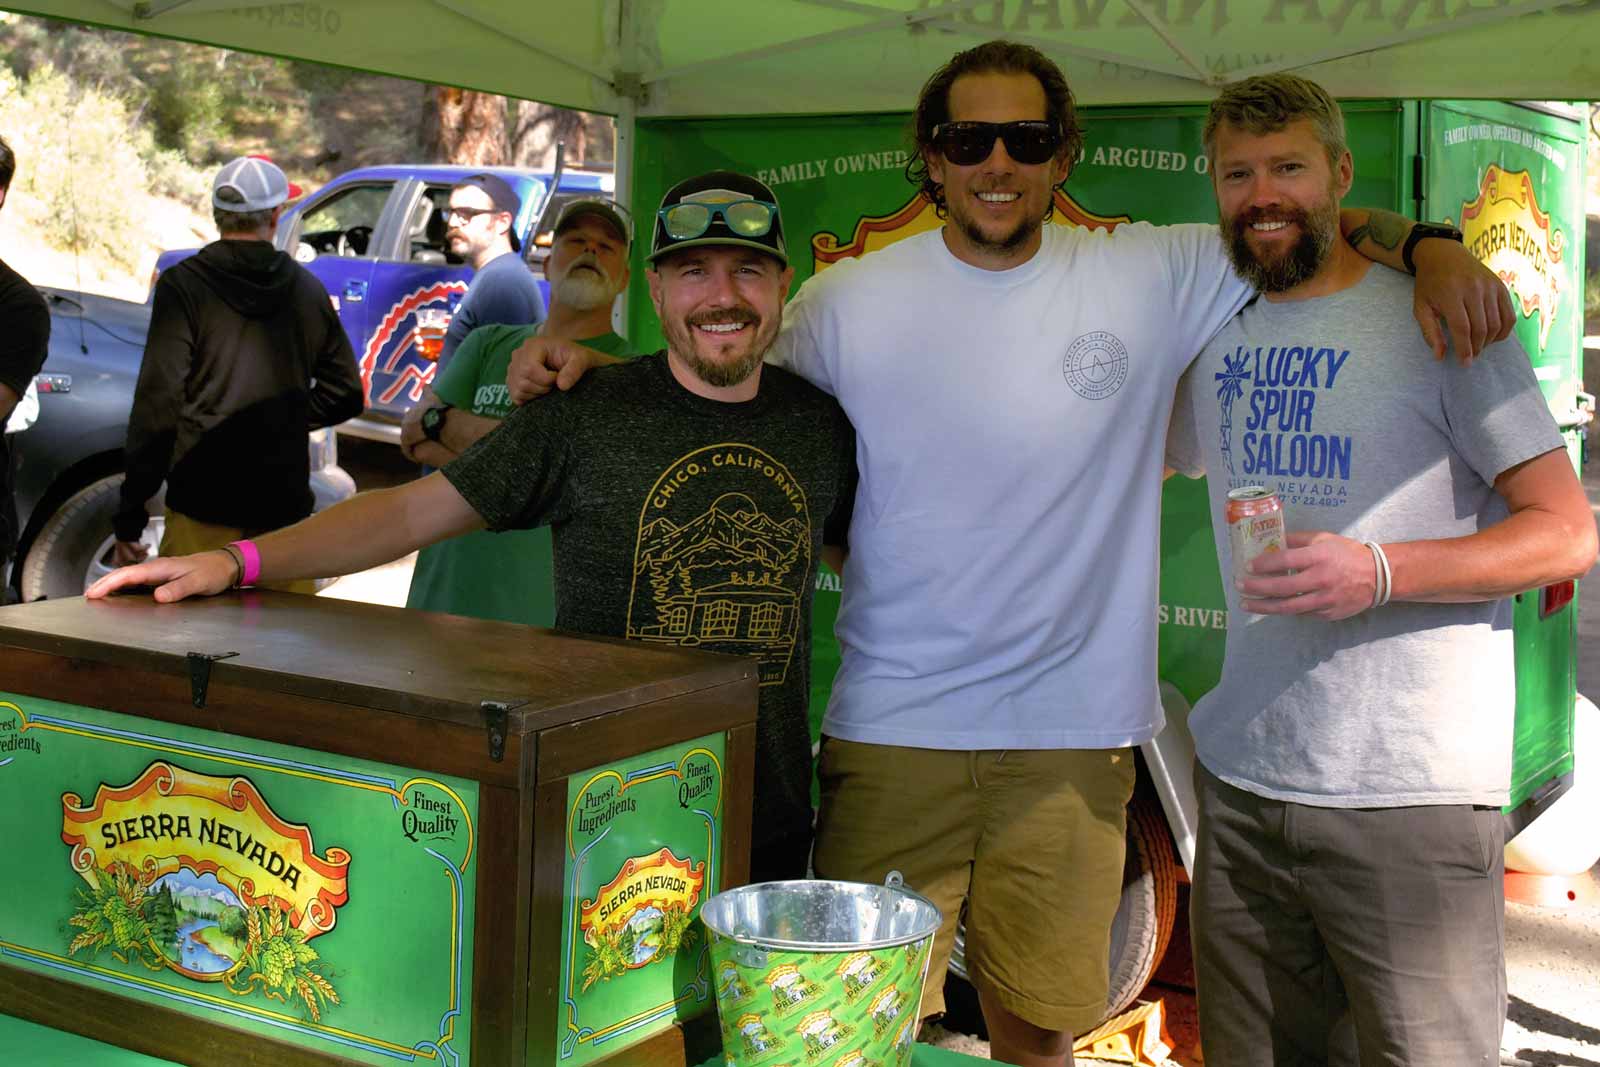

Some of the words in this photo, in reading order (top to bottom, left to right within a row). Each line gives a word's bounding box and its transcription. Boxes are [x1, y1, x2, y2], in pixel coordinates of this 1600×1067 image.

[757, 159, 828, 186] FAMILY
[1091, 146, 1187, 172] ARGUED
[1469, 223, 1507, 261] ERRA
[1253, 346, 1350, 389] LUCKY
[1246, 389, 1316, 432] SPUR
[1243, 432, 1352, 480] SALOON
[653, 462, 707, 510] CHICO,
[712, 453, 802, 514] CALIFORNIA
[1278, 481, 1347, 497] NEVADA
[686, 761, 711, 780] Finest
[413, 790, 453, 815] Finest
[585, 784, 615, 809] Purest
[679, 773, 715, 809] Quality
[402, 809, 458, 841] Quality
[577, 797, 636, 835] Ingredients
[101, 812, 192, 850] SIERRA
[198, 817, 302, 891] NEVADA
[600, 879, 642, 922] SIERRA
[645, 875, 687, 895] NEVADA
[775, 994, 799, 1011] PALE
[800, 983, 818, 1001] ALE
[847, 976, 870, 999] PALE
[871, 960, 889, 980] ALE
[807, 1040, 831, 1057] PALE
[832, 1026, 851, 1042] ALE
